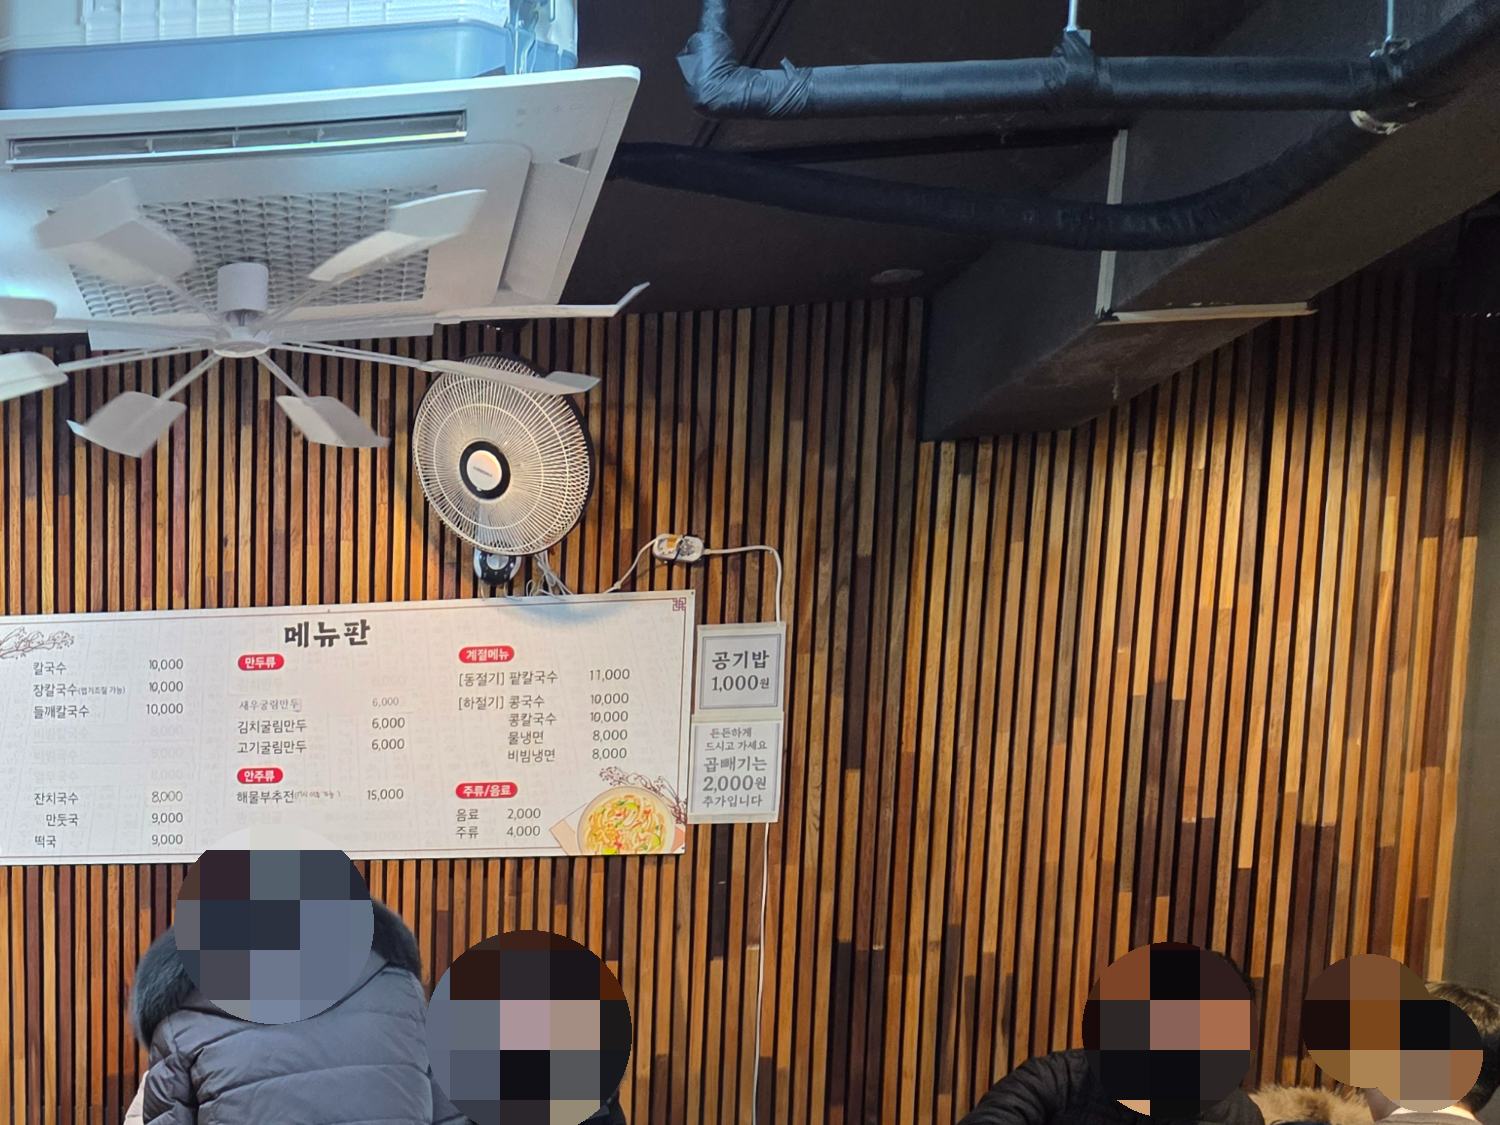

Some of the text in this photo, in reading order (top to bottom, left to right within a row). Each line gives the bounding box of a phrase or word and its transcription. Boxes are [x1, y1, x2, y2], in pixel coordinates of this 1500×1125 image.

[284, 619, 371, 648] 메뉴판
[245, 656, 276, 669] 만두류
[466, 648, 510, 661] 계절메뉴
[712, 650, 769, 670] 공기밥
[33, 659, 184, 676] 칼국수 10,000
[459, 669, 631, 687] [동절기] 팥칼국수 11,000
[711, 675, 770, 692] 1,000원
[33, 683, 77, 698] 장칼국수
[149, 681, 184, 694] 10,000
[372, 697, 399, 708] 6,000
[458, 693, 630, 711] [하절기] 콩국수 10,000
[33, 703, 184, 719] 들깨칼국수 10,000
[509, 711, 629, 727] 콩칼국수 10,000
[237, 717, 405, 734] 김치굴림만두 6,000
[709, 727, 752, 739] 든든하게
[507, 729, 628, 745] 물냉면 8,000
[237, 738, 405, 755] 고기굴림만두 6,000
[705, 740, 767, 752] 드시고 가세요
[507, 748, 627, 763] 비빔냉면 8,000
[703, 756, 768, 773] 곱빼기는
[244, 770, 275, 783] 안주류
[702, 775, 767, 794] 2,000원
[34, 790, 184, 806] 잔치국수 8,000
[236, 788, 404, 804] 해물부추전 15,000
[462, 784, 512, 798] 주류/음료
[702, 795, 763, 808] 추가입니다
[46, 812, 184, 827] 만둣국 9,000
[456, 808, 541, 822] 음료 2,000
[456, 825, 541, 840] 주류 4,000
[34, 834, 184, 849] 떡국 9,000
